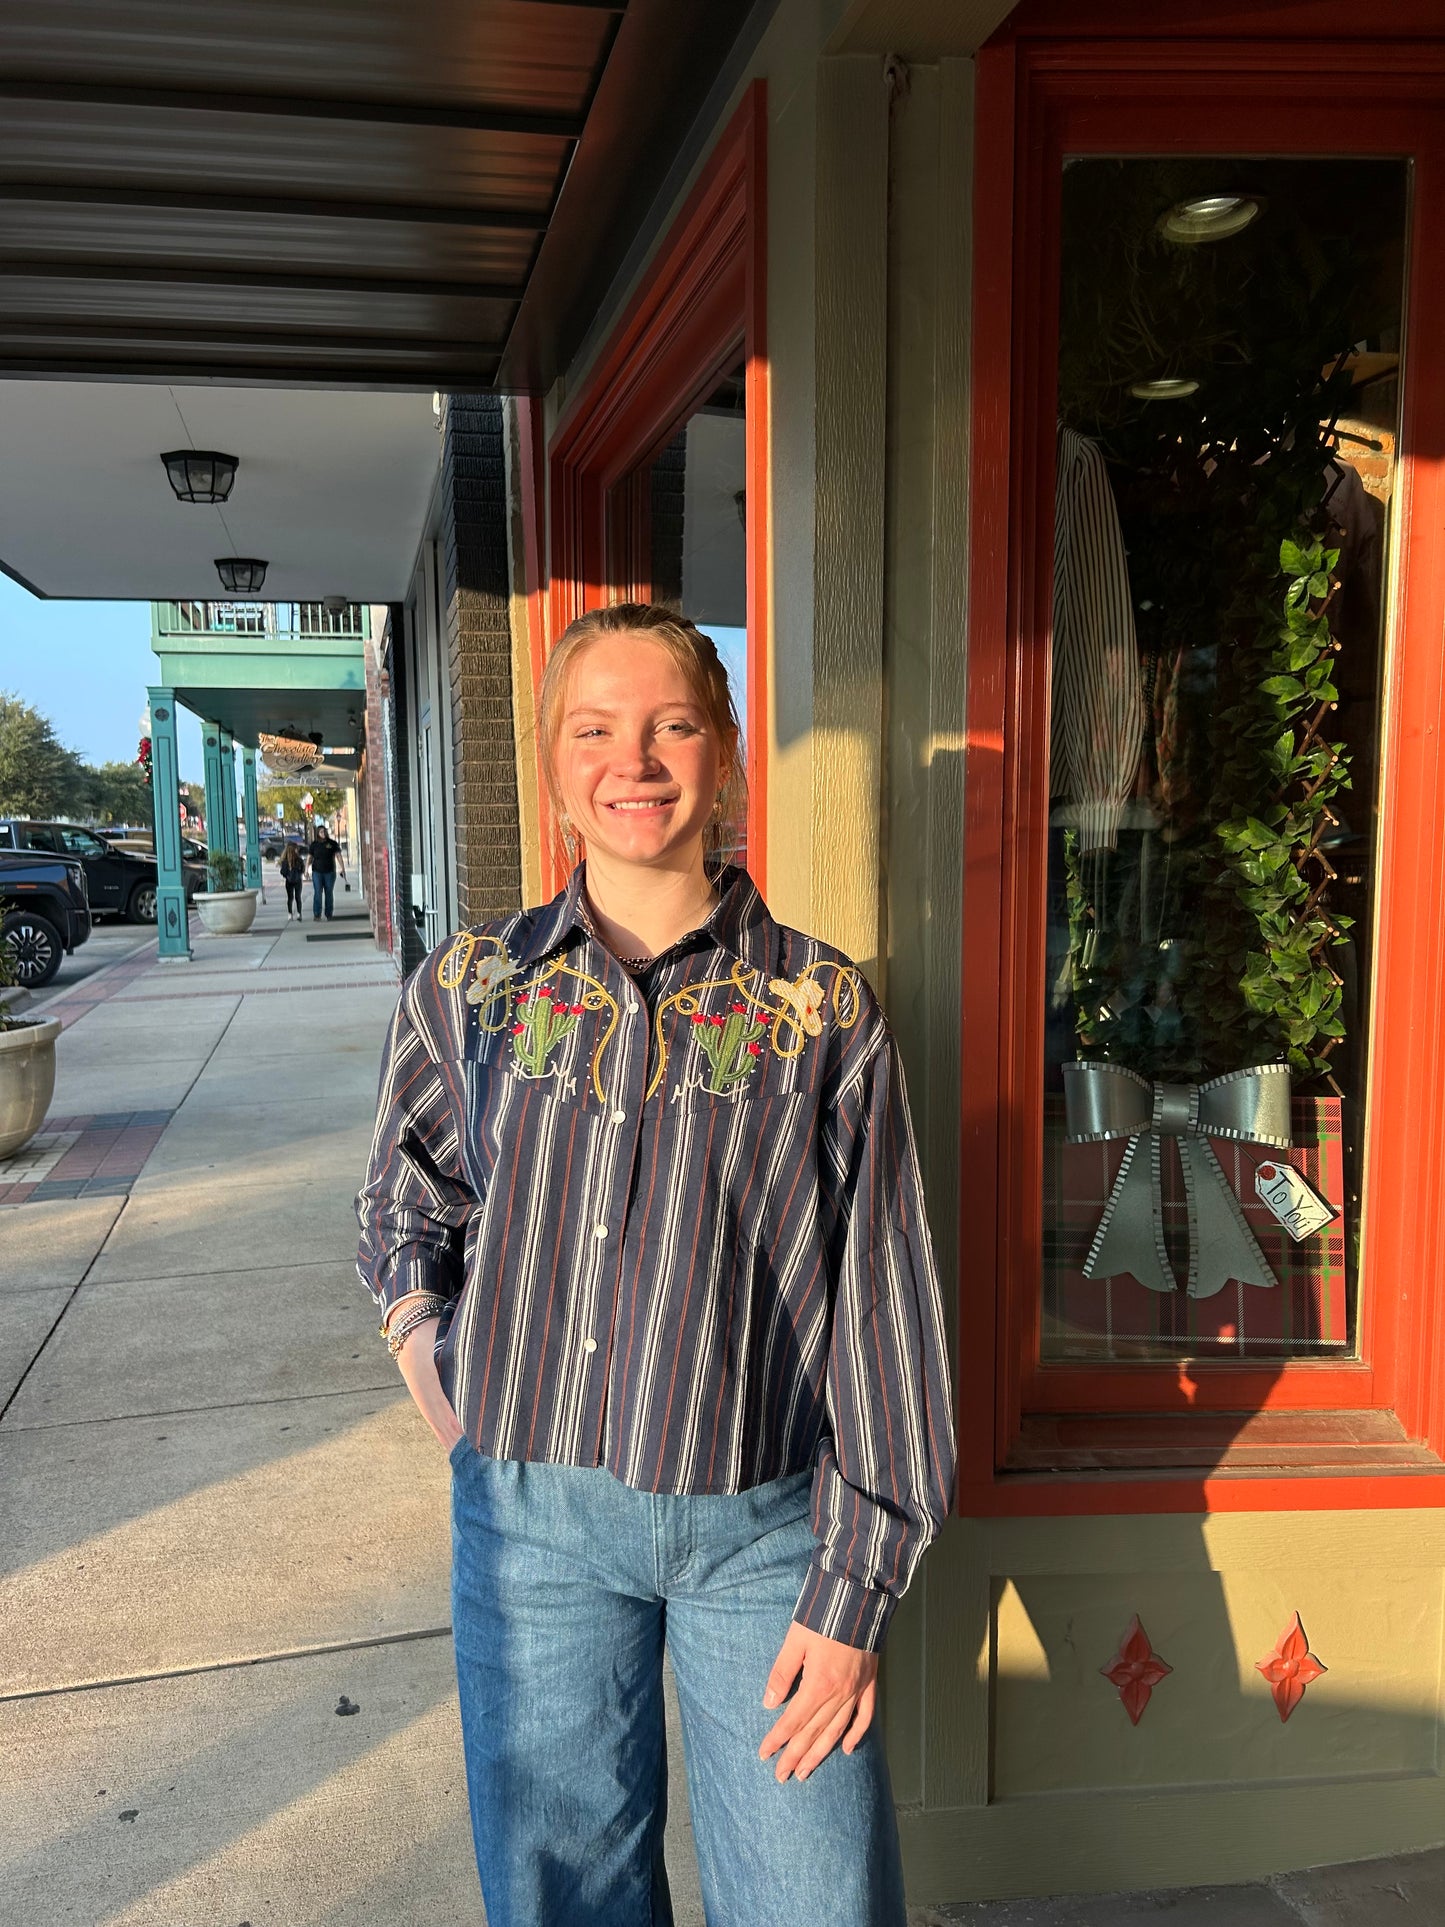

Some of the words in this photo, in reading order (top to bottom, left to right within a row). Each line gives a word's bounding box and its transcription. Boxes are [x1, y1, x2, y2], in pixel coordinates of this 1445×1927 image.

[262, 742, 315, 753] Chocolate
[277, 753, 323, 767] Gallery
[1267, 1171, 1294, 1204] To
[1284, 1194, 1313, 1231] You
